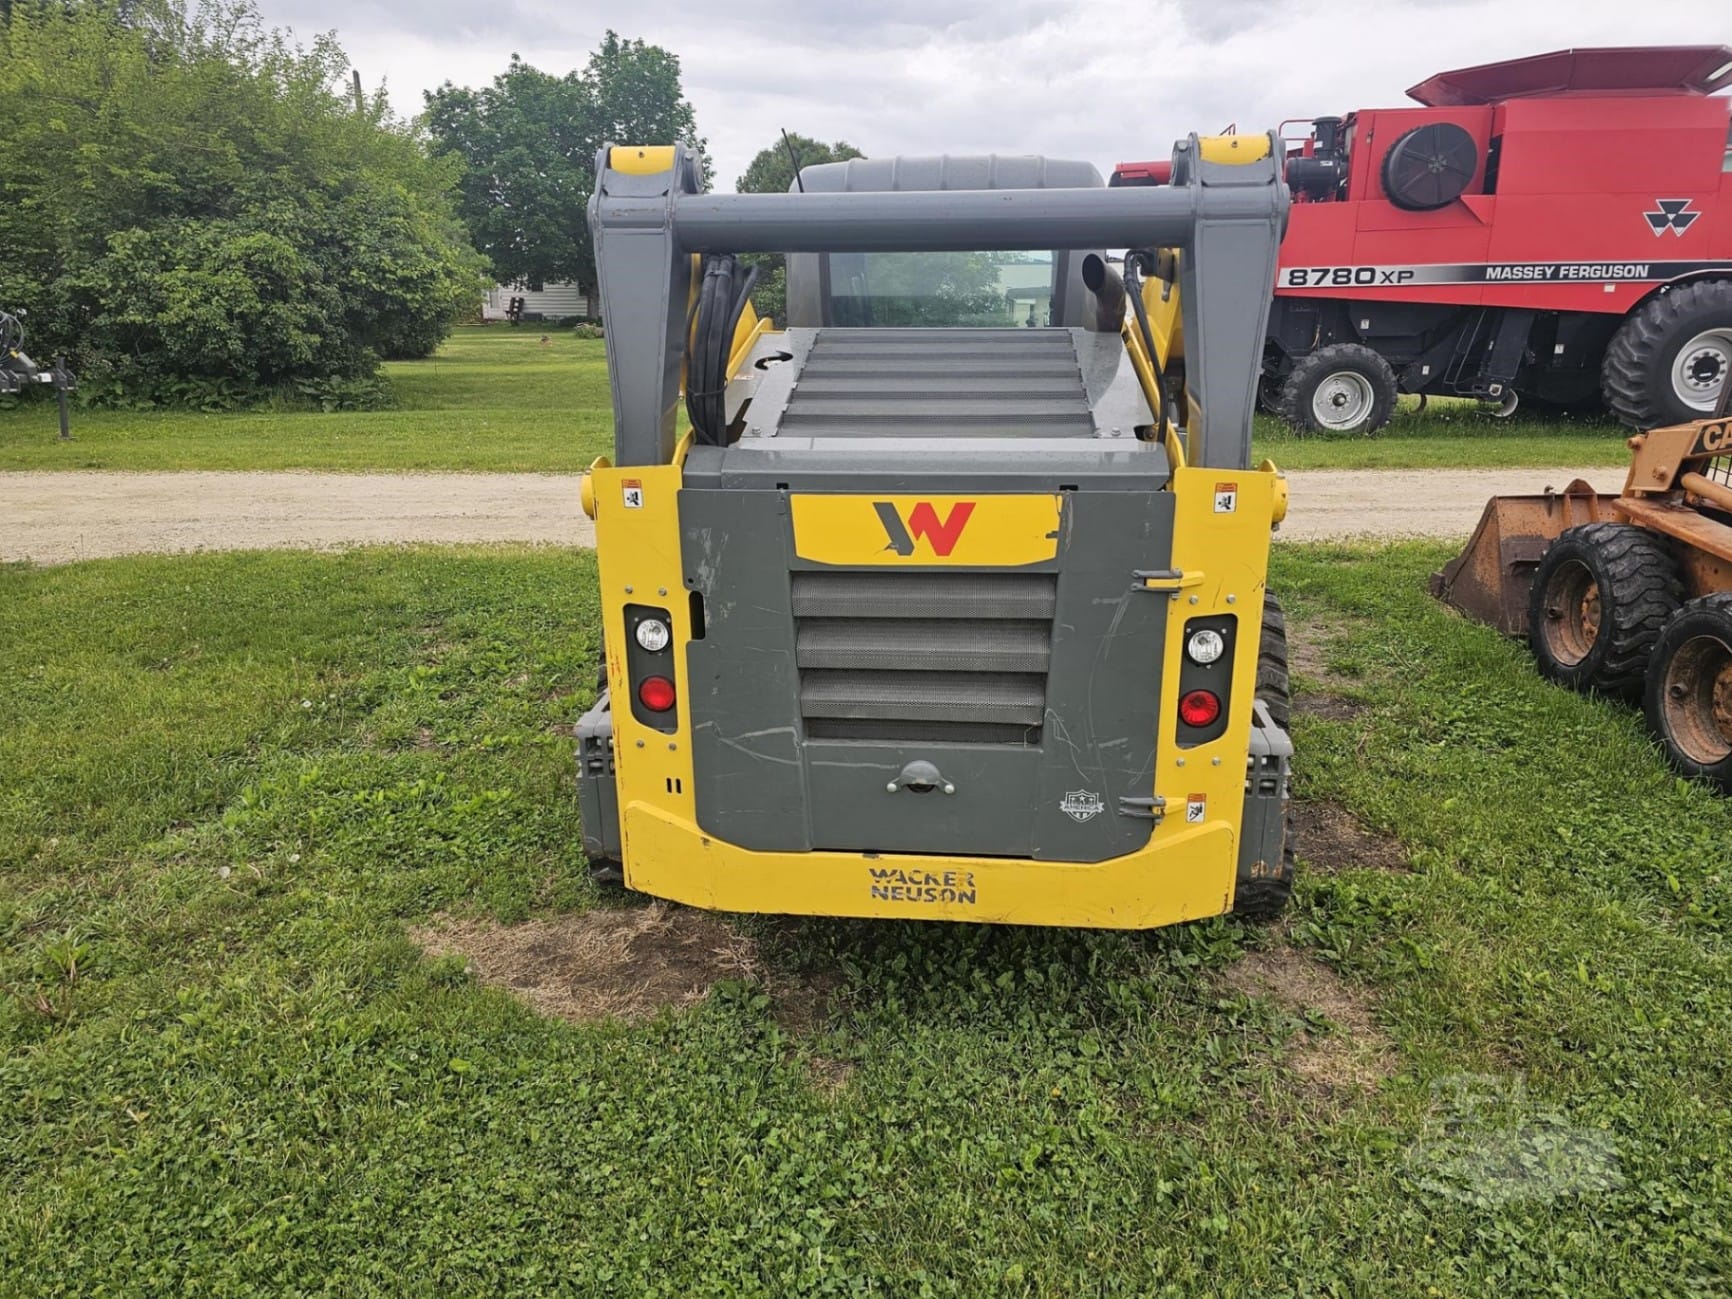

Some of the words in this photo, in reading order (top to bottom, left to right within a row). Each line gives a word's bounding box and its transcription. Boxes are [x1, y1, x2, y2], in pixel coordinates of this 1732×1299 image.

[1485, 266, 1555, 280] MASSEY
[1559, 264, 1649, 279] FERGUSON
[869, 868, 976, 887] WACKER
[871, 885, 976, 904] NEUSON
